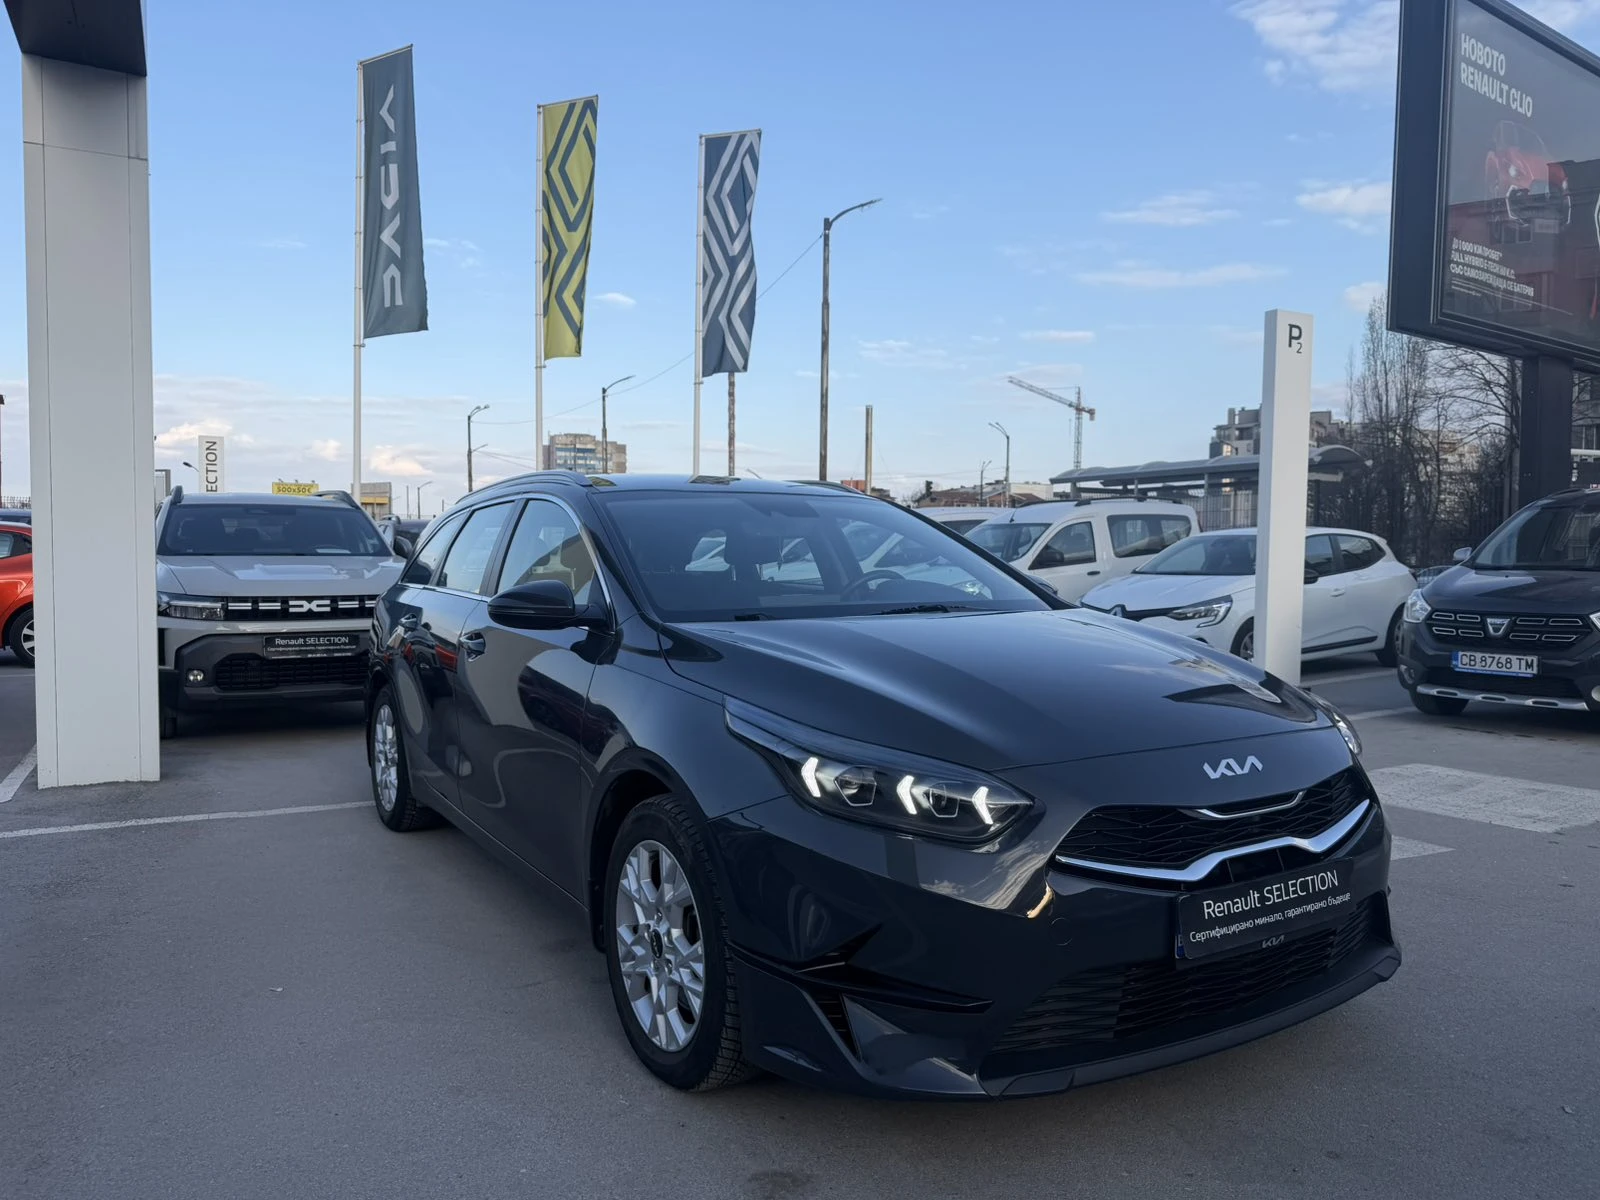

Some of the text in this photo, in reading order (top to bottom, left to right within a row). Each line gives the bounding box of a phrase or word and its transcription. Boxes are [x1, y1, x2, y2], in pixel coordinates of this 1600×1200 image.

[1461, 33, 1506, 76] НОВОТО
[1461, 62, 1533, 117] RENAULT CLIO
[275, 636, 349, 645] Renault SELECTION
[1480, 655, 1513, 670] 8768
[1203, 755, 1263, 779] KIA
[1203, 870, 1339, 920] Renault SELECTION
[1189, 892, 1351, 942] Сертифицирано минало, гарантирано бъдеще
